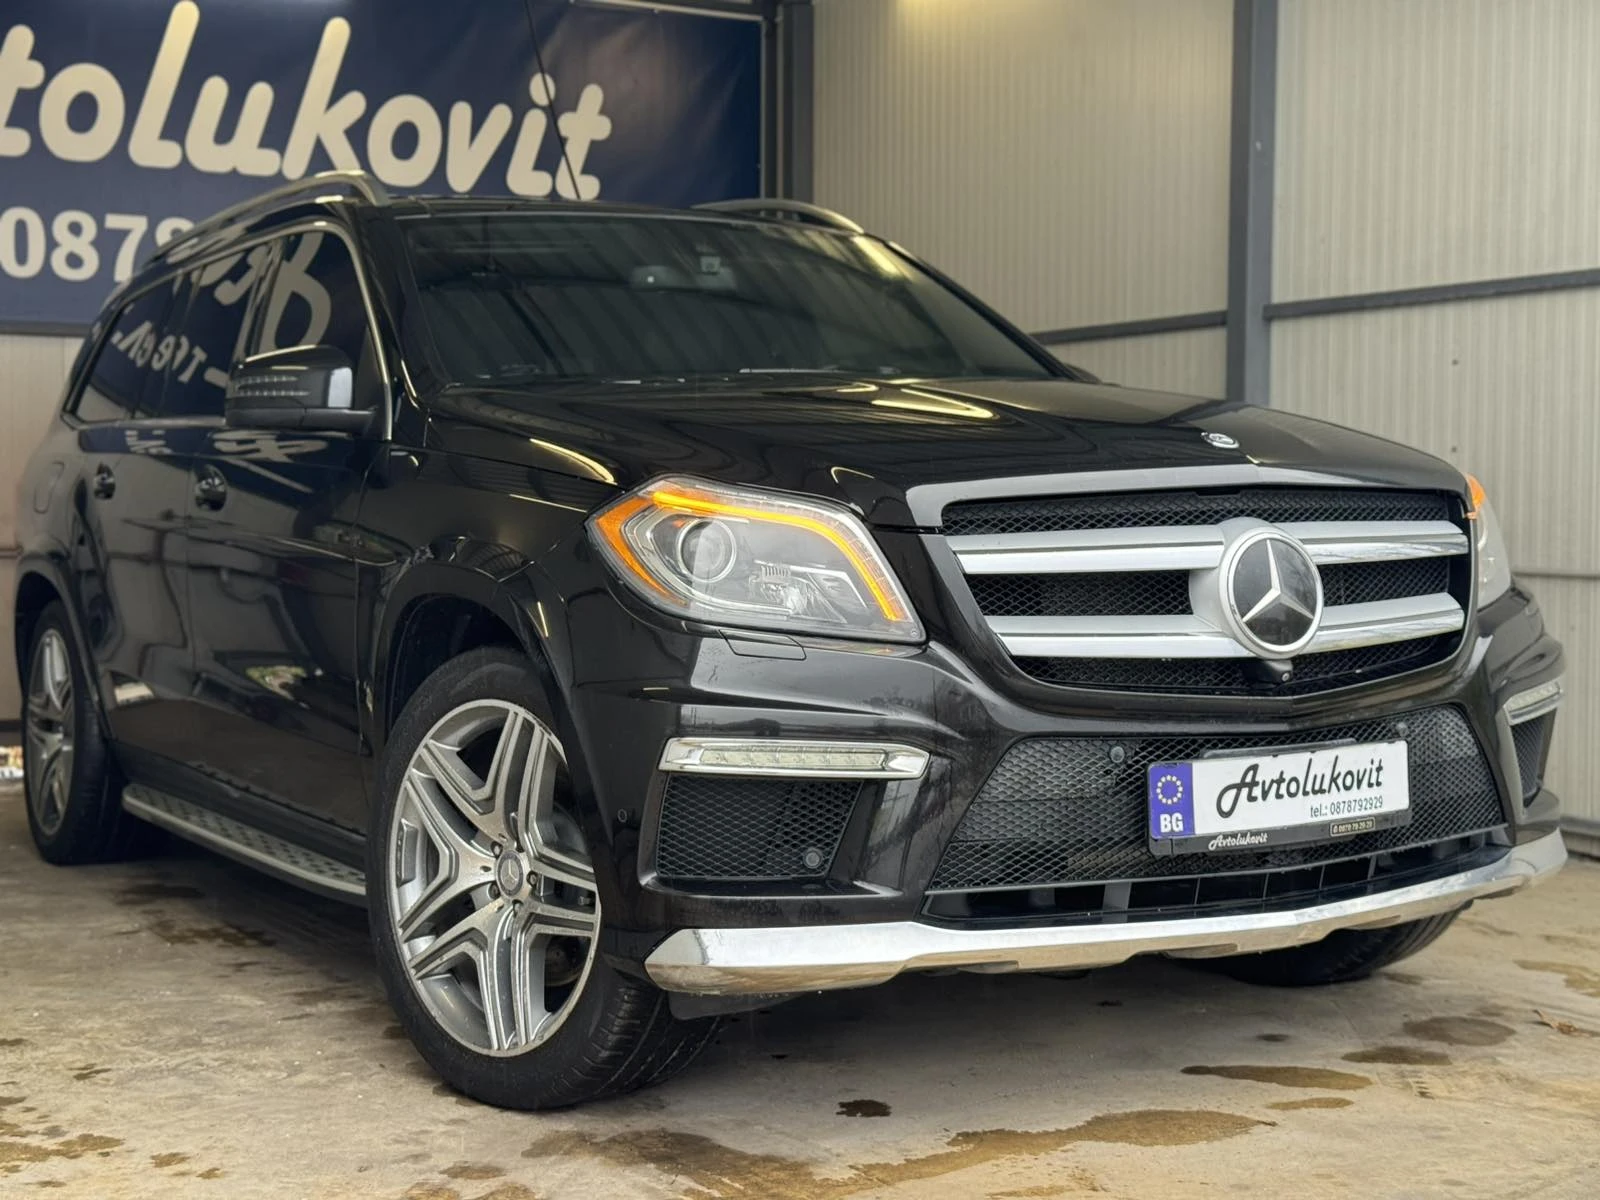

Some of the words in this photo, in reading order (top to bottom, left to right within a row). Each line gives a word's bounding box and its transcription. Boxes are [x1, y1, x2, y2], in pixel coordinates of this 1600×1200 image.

[1216, 754, 1384, 819] Avtolukovit
[1310, 803, 1328, 818] tel.:
[1330, 795, 1384, 815] 0878792929
[1159, 812, 1184, 833] BG
[1208, 831, 1268, 851] Avtolukovit
